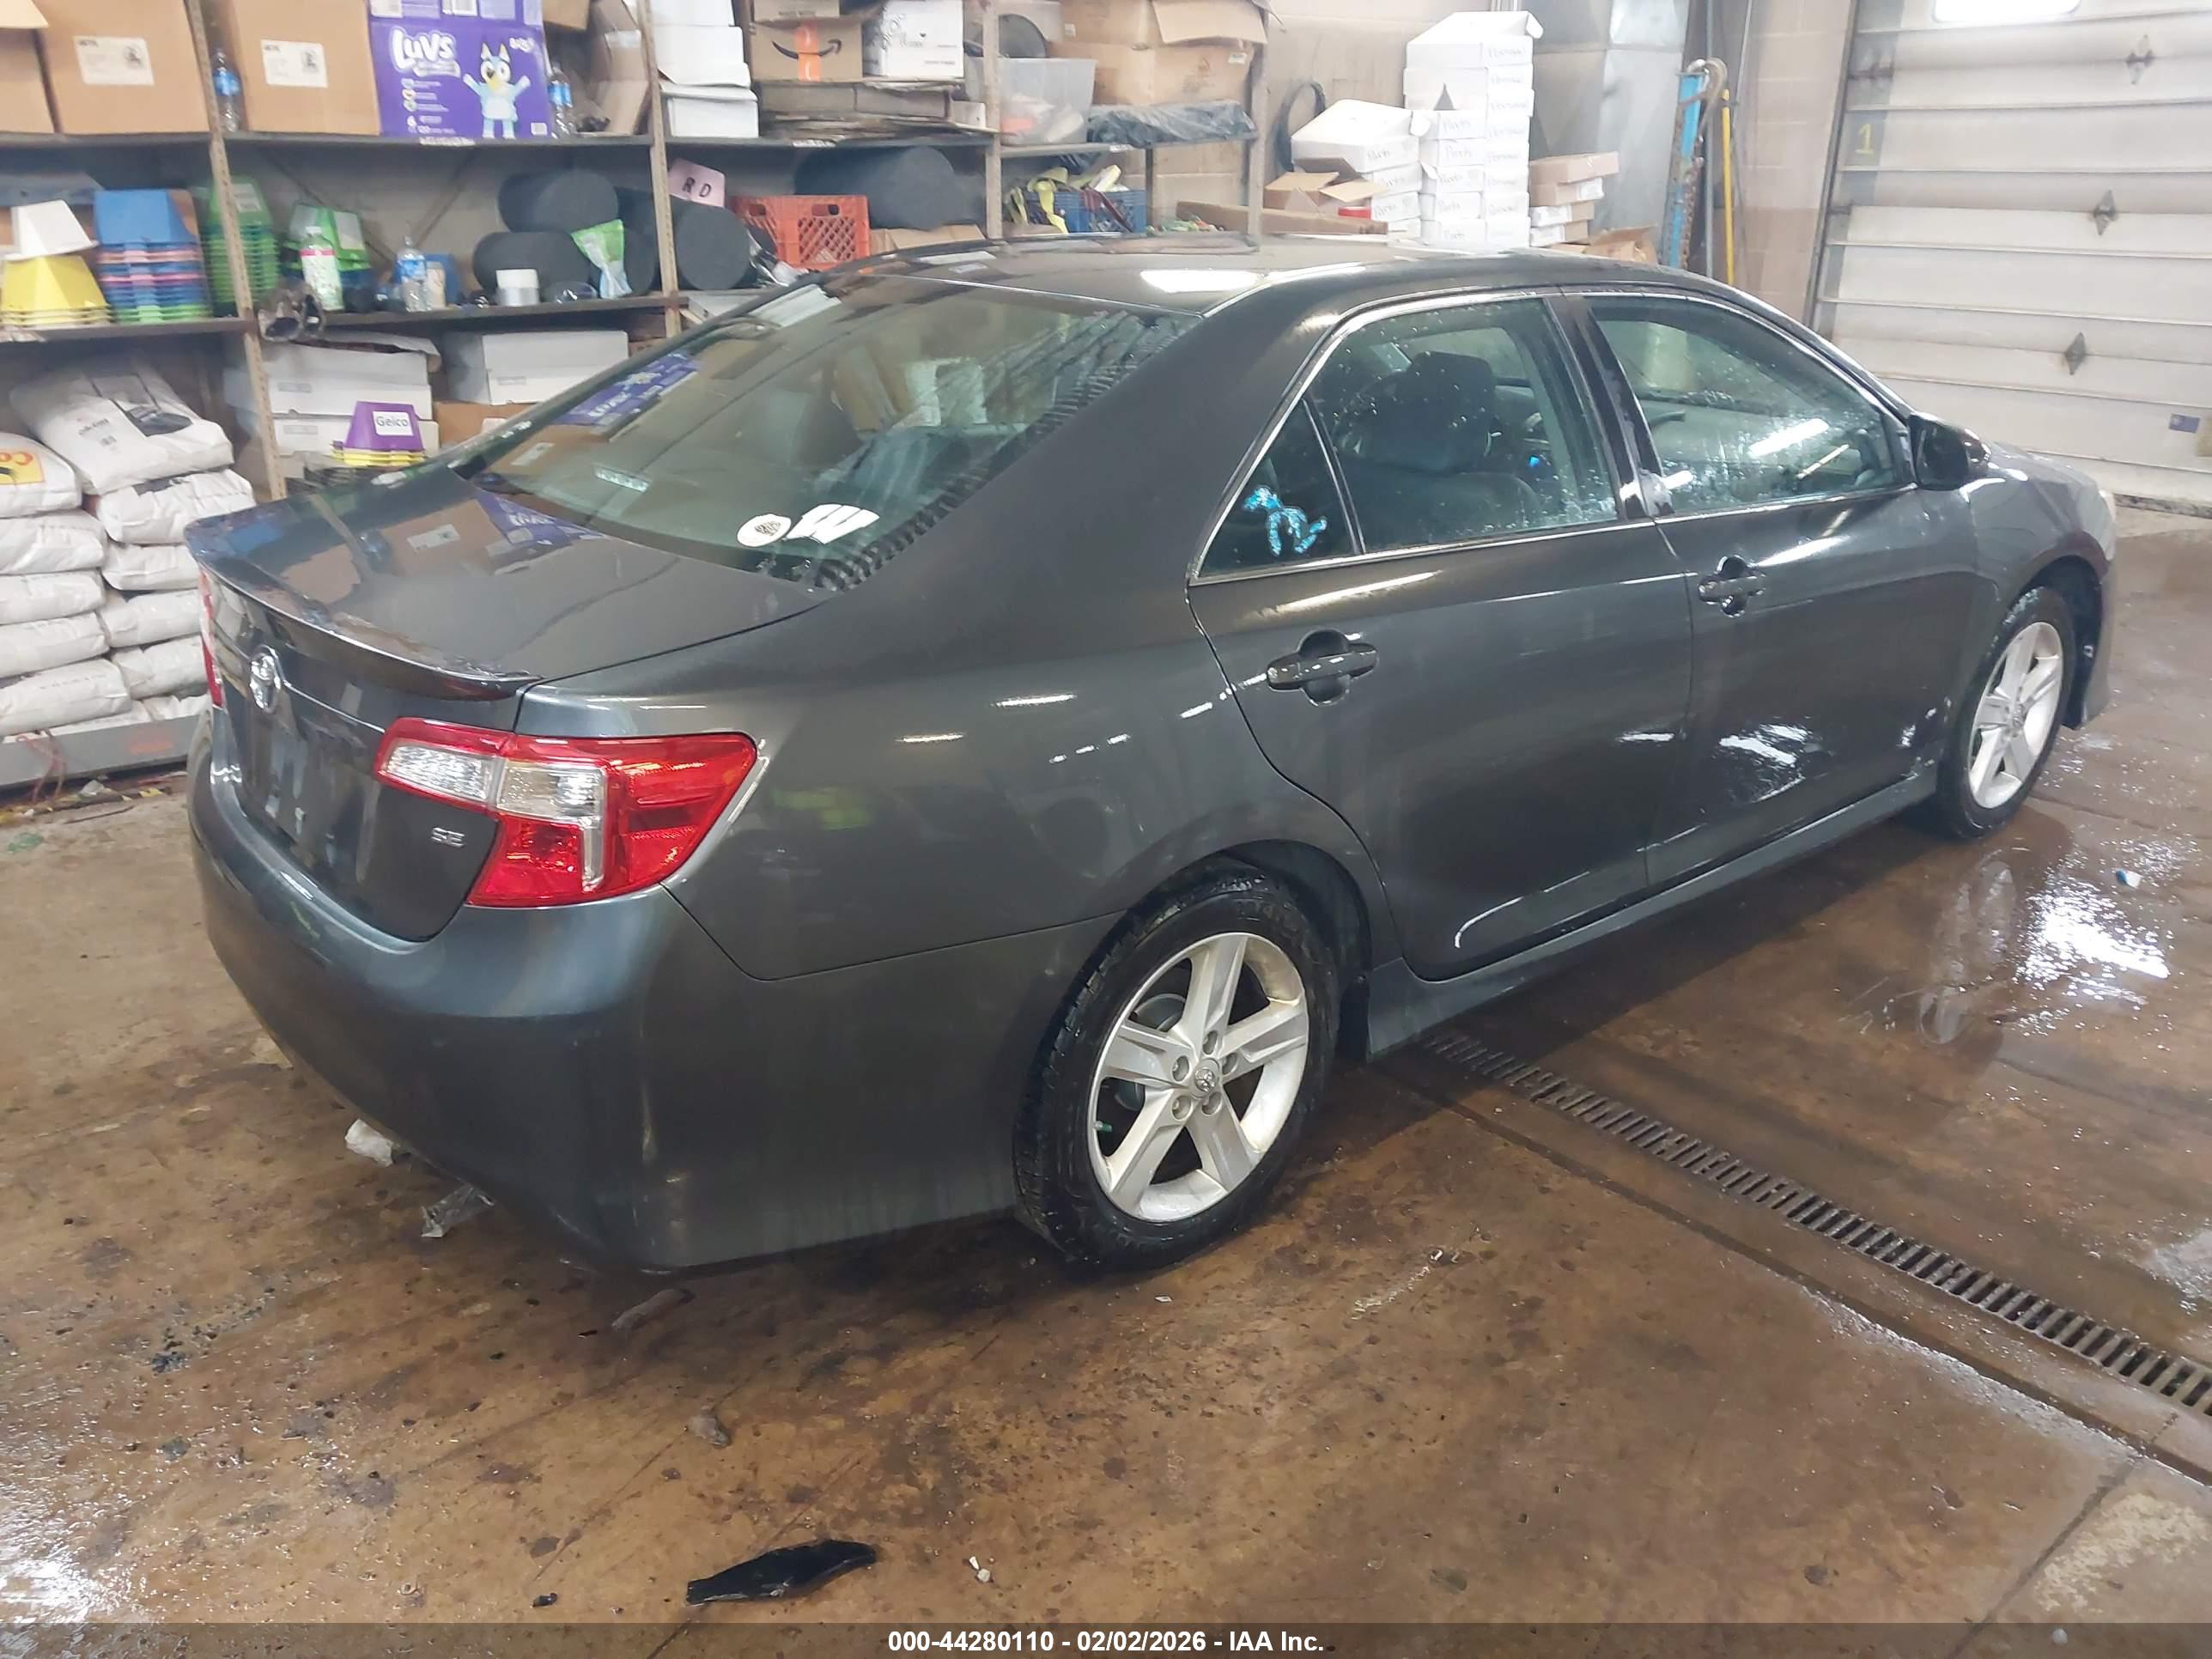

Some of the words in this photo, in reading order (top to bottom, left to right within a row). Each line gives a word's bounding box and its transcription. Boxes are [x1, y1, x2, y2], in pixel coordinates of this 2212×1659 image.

[392, 27, 455, 70] Luvs
[1855, 124, 1875, 155] 1
[699, 183, 712, 198] D
[376, 416, 409, 428] Geico
[431, 827, 465, 848] SE
